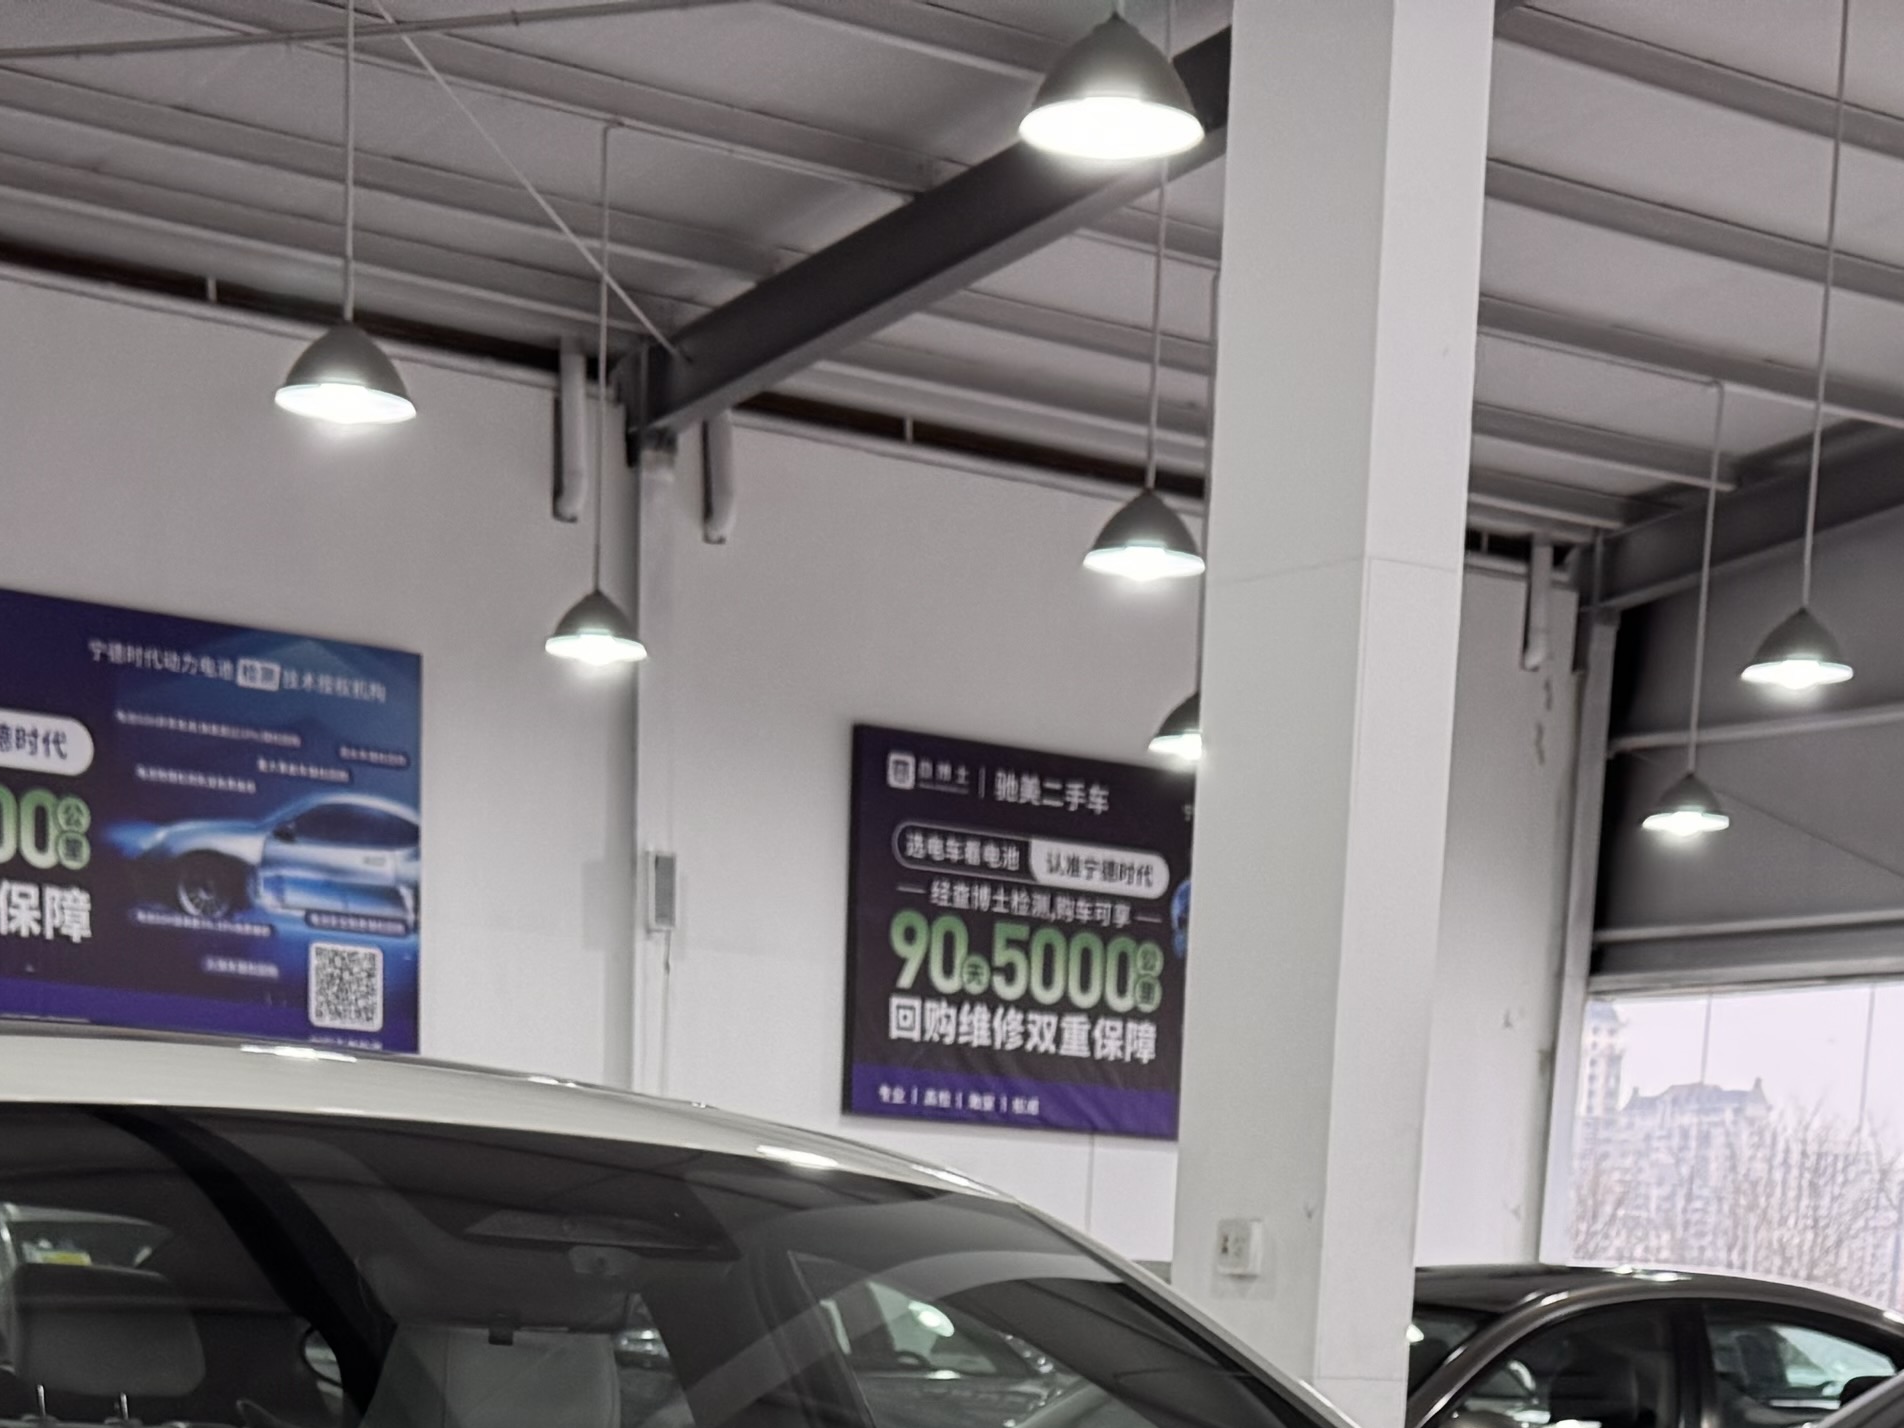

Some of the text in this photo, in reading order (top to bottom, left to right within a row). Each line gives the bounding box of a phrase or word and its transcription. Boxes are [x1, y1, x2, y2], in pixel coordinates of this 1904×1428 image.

[889, 995, 1157, 1064] 回购维修双重保障
